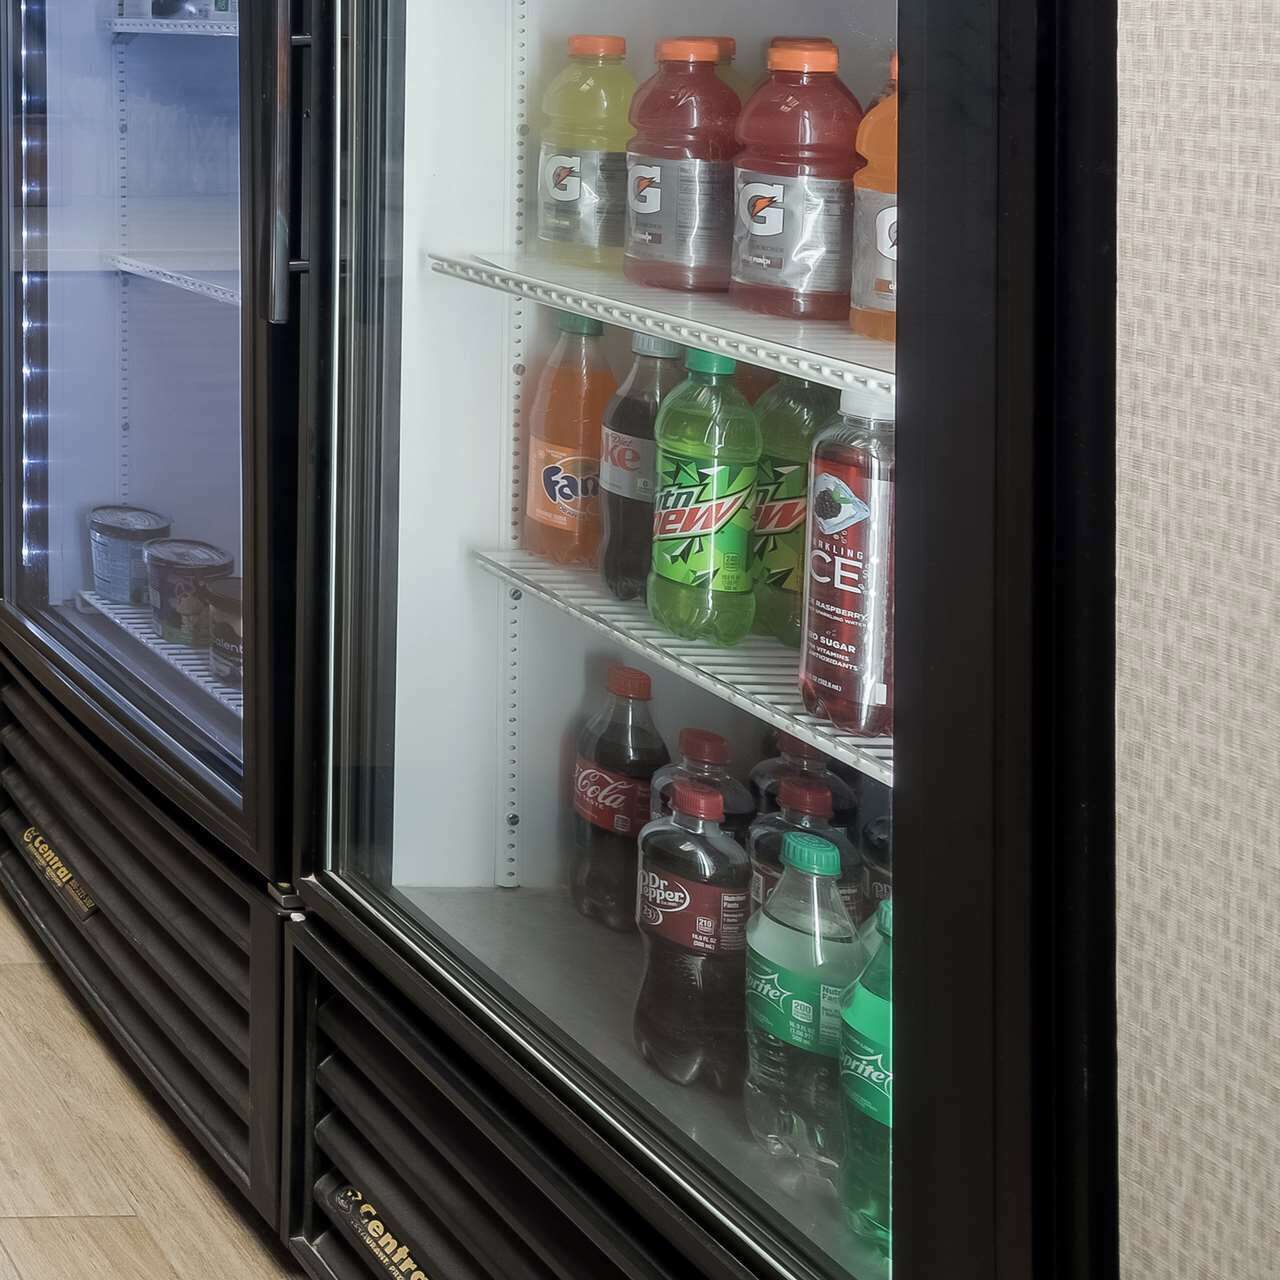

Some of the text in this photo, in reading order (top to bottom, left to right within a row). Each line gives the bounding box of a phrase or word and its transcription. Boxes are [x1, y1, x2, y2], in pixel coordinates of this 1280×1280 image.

[545, 154, 582, 202] G
[628, 165, 662, 214] G
[740, 182, 785, 236] G
[810, 549, 863, 595] CE
[815, 600, 867, 621] RASPBERRY
[820, 636, 857, 654] SUGAR
[747, 976, 781, 1000] prite
